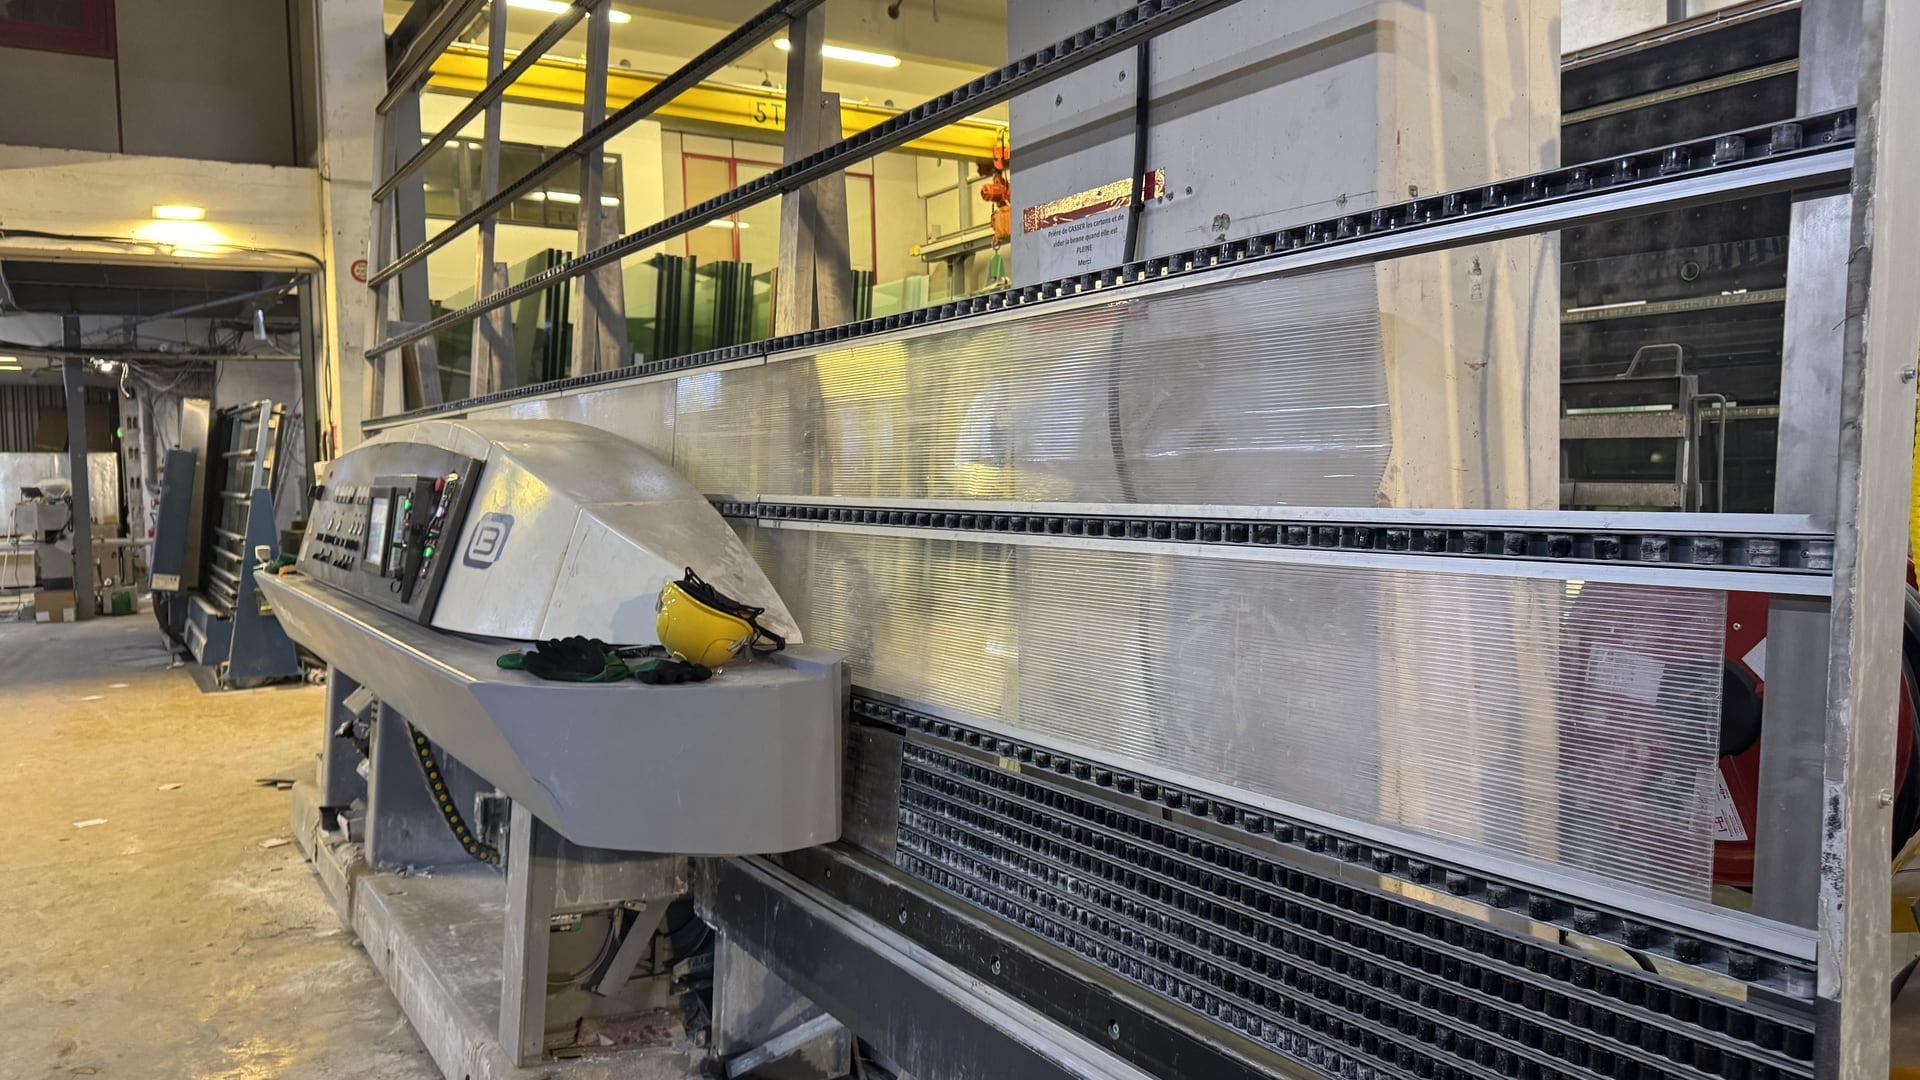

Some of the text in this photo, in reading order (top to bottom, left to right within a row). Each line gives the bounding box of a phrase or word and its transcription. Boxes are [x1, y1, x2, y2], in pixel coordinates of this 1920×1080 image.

[753, 101, 782, 125] 5T
[1068, 223, 1085, 233] CASSER
[1093, 218, 1111, 227] cartons
[1085, 232, 1100, 242] quand
[1100, 229, 1110, 237] elle
[1110, 227, 1118, 235] est
[1076, 244, 1093, 254] PLEINE
[1078, 257, 1092, 266] Merci
